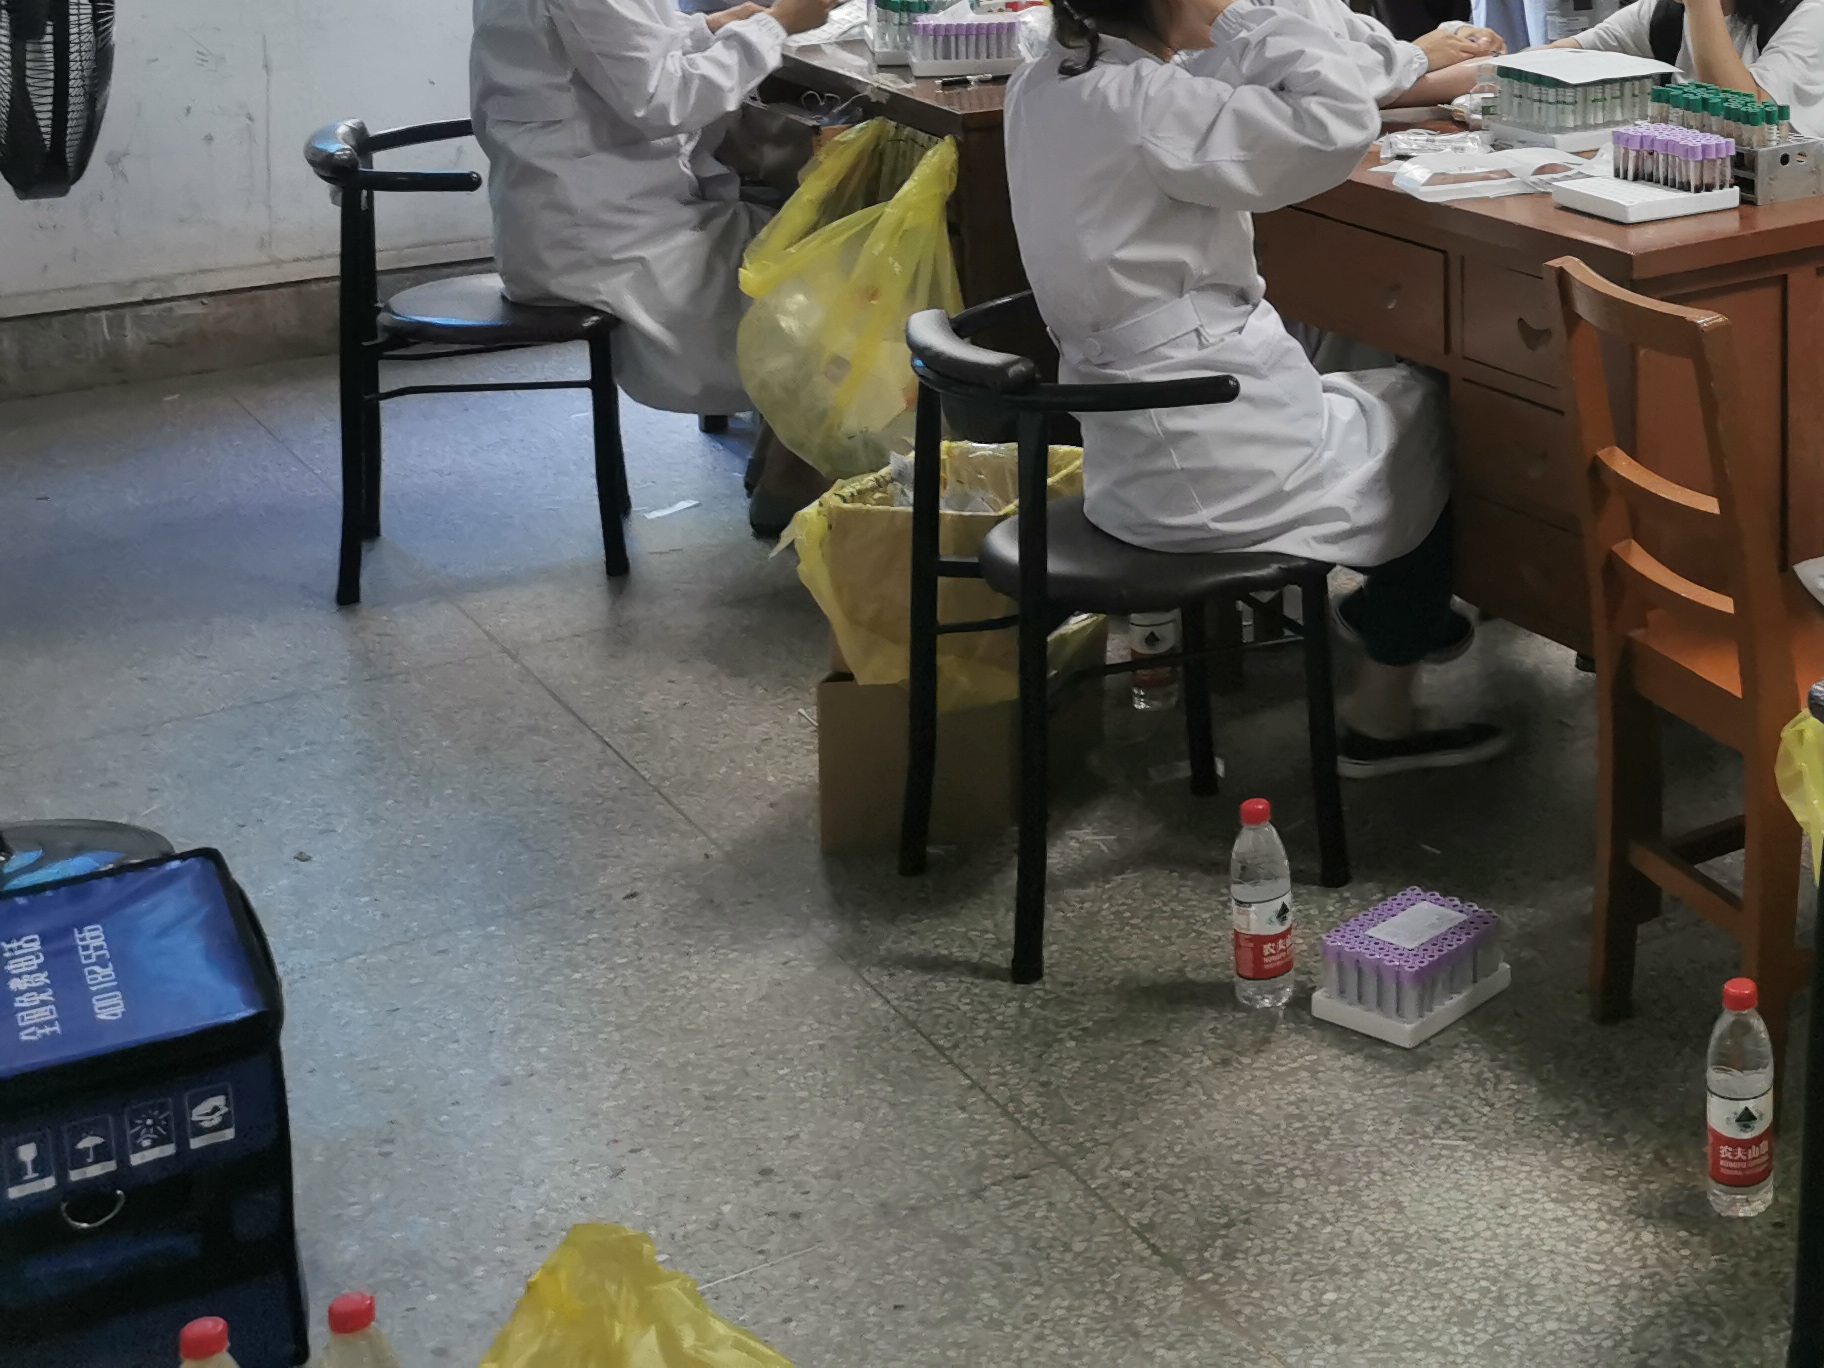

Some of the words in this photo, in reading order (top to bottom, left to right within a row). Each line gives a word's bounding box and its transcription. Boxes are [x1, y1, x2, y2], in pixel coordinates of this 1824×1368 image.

[0, 934, 62, 1041] 全国免费电话
